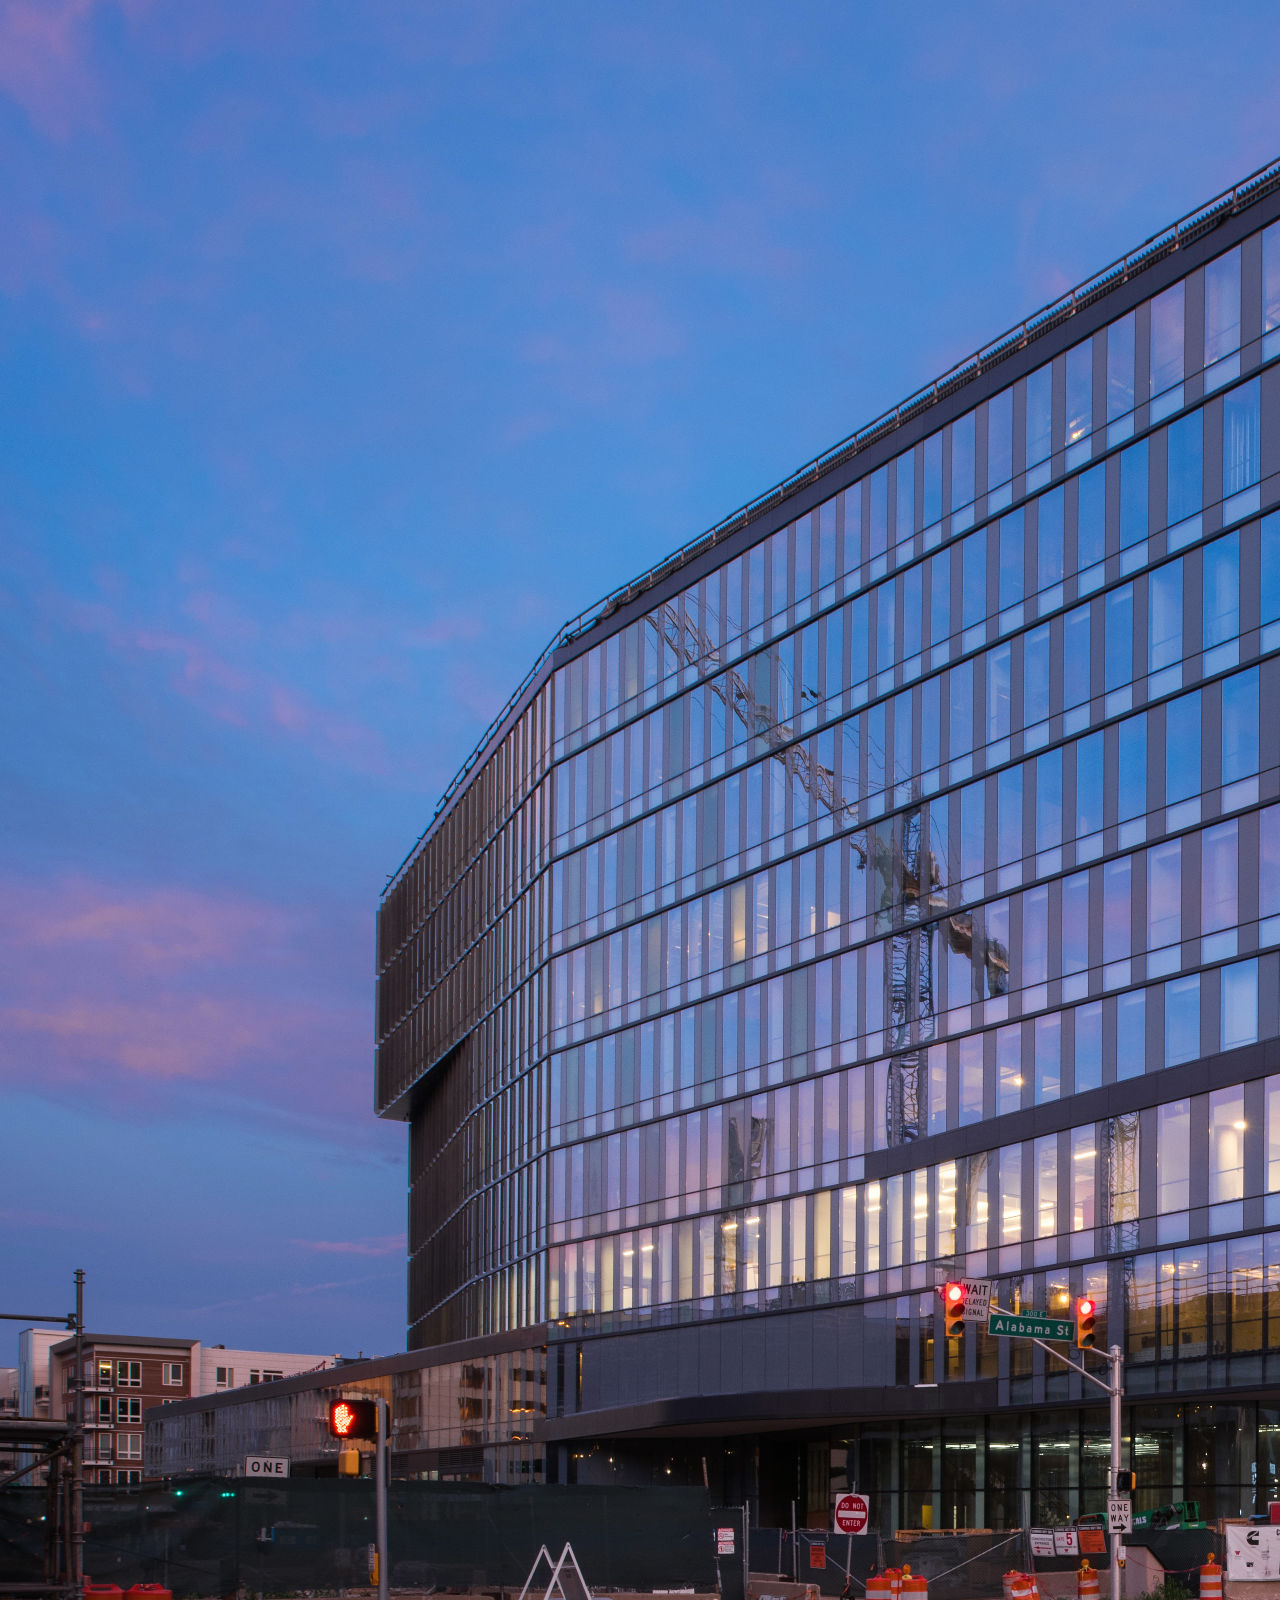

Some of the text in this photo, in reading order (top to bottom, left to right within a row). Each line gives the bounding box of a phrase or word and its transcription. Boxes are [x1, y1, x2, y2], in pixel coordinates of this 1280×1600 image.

[963, 1283, 988, 1295] WAIT
[995, 1319, 1069, 1336] Alabama St
[251, 1461, 284, 1474] ONE
[852, 1502, 864, 1510] NOT
[1110, 1503, 1129, 1512] ONE
[842, 1519, 861, 1527] ENTER
[1110, 1514, 1129, 1522] WAY
[1066, 1532, 1073, 1546] 5
